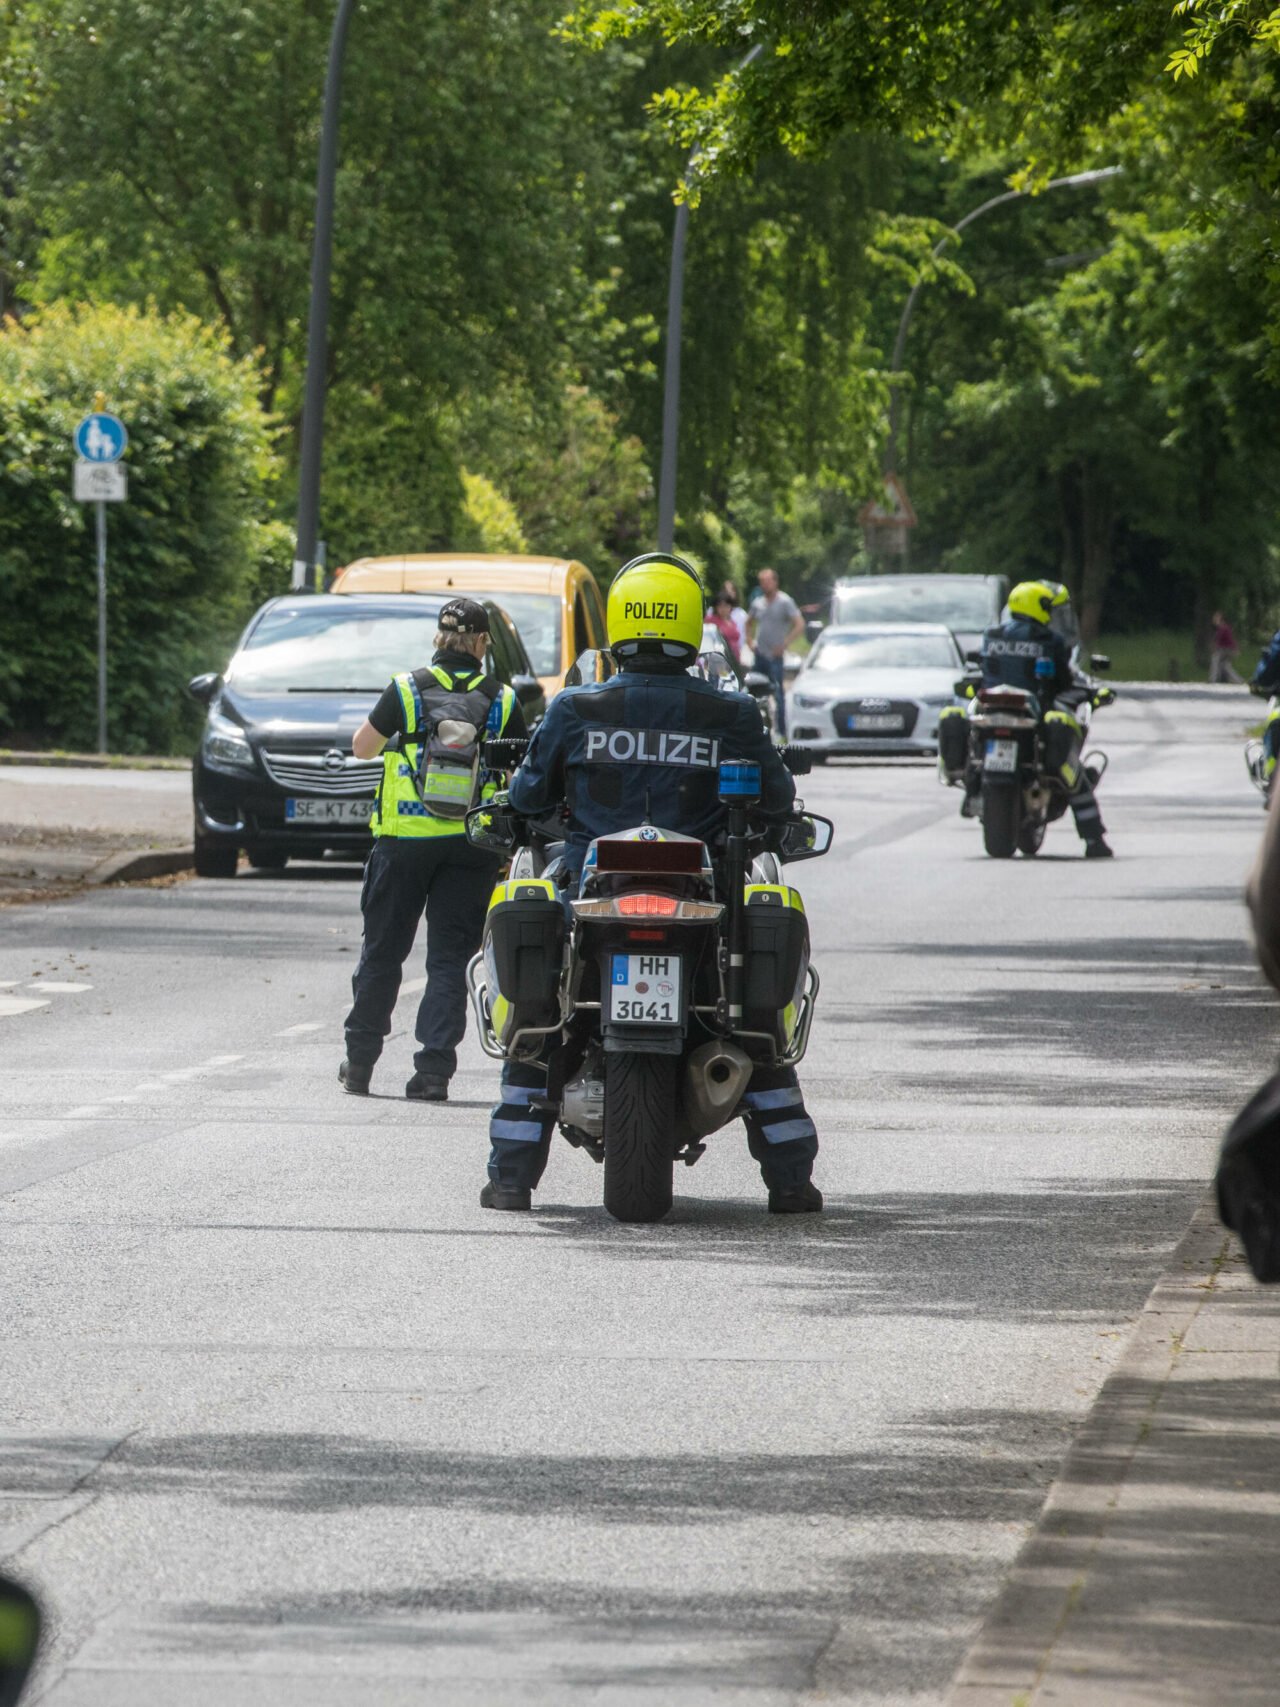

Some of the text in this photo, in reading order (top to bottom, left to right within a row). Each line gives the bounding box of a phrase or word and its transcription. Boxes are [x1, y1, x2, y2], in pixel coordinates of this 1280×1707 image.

[625, 602, 678, 620] POLIZEI
[586, 730, 718, 768] POLIZEI
[427, 777, 470, 795] Polize
[296, 802, 315, 817] SE
[326, 802, 346, 817] KT
[640, 956, 669, 976] HH
[616, 973, 624, 982] D
[616, 1000, 673, 1021] 3041
